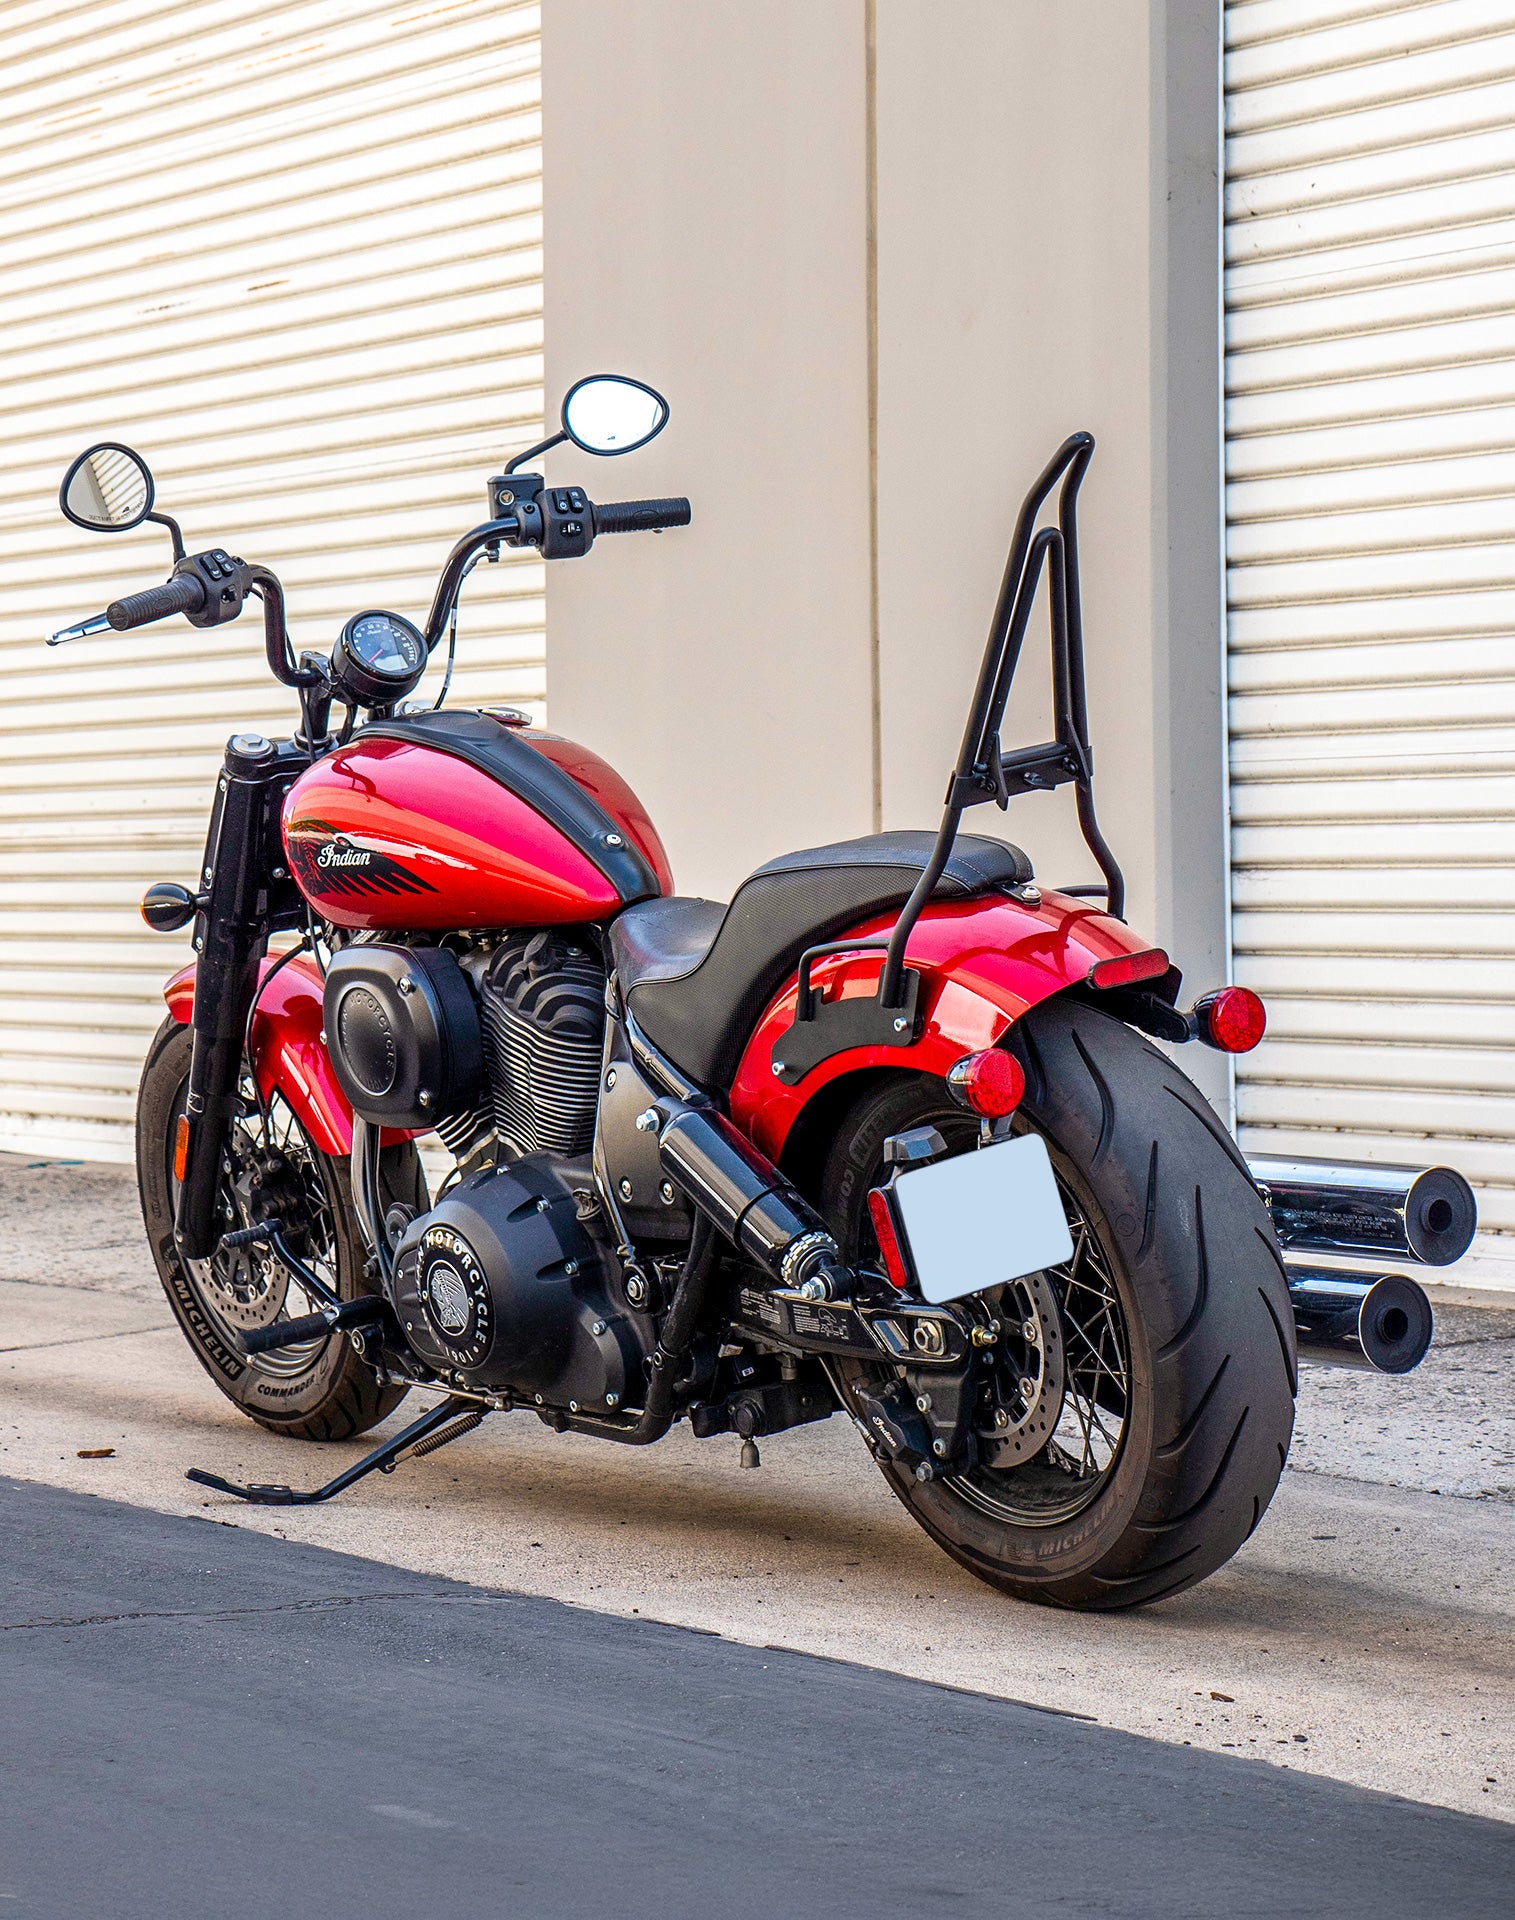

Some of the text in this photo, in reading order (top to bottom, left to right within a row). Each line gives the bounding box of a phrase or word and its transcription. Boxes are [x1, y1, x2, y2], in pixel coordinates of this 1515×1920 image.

[317, 843, 371, 868] Indian
[425, 1230, 489, 1344] MOTORCYCLE
[174, 1279, 242, 1377] MICHELIN
[444, 1344, 474, 1363] 1901
[257, 1374, 316, 1398] COMMANDER
[872, 1416, 898, 1448] Indian
